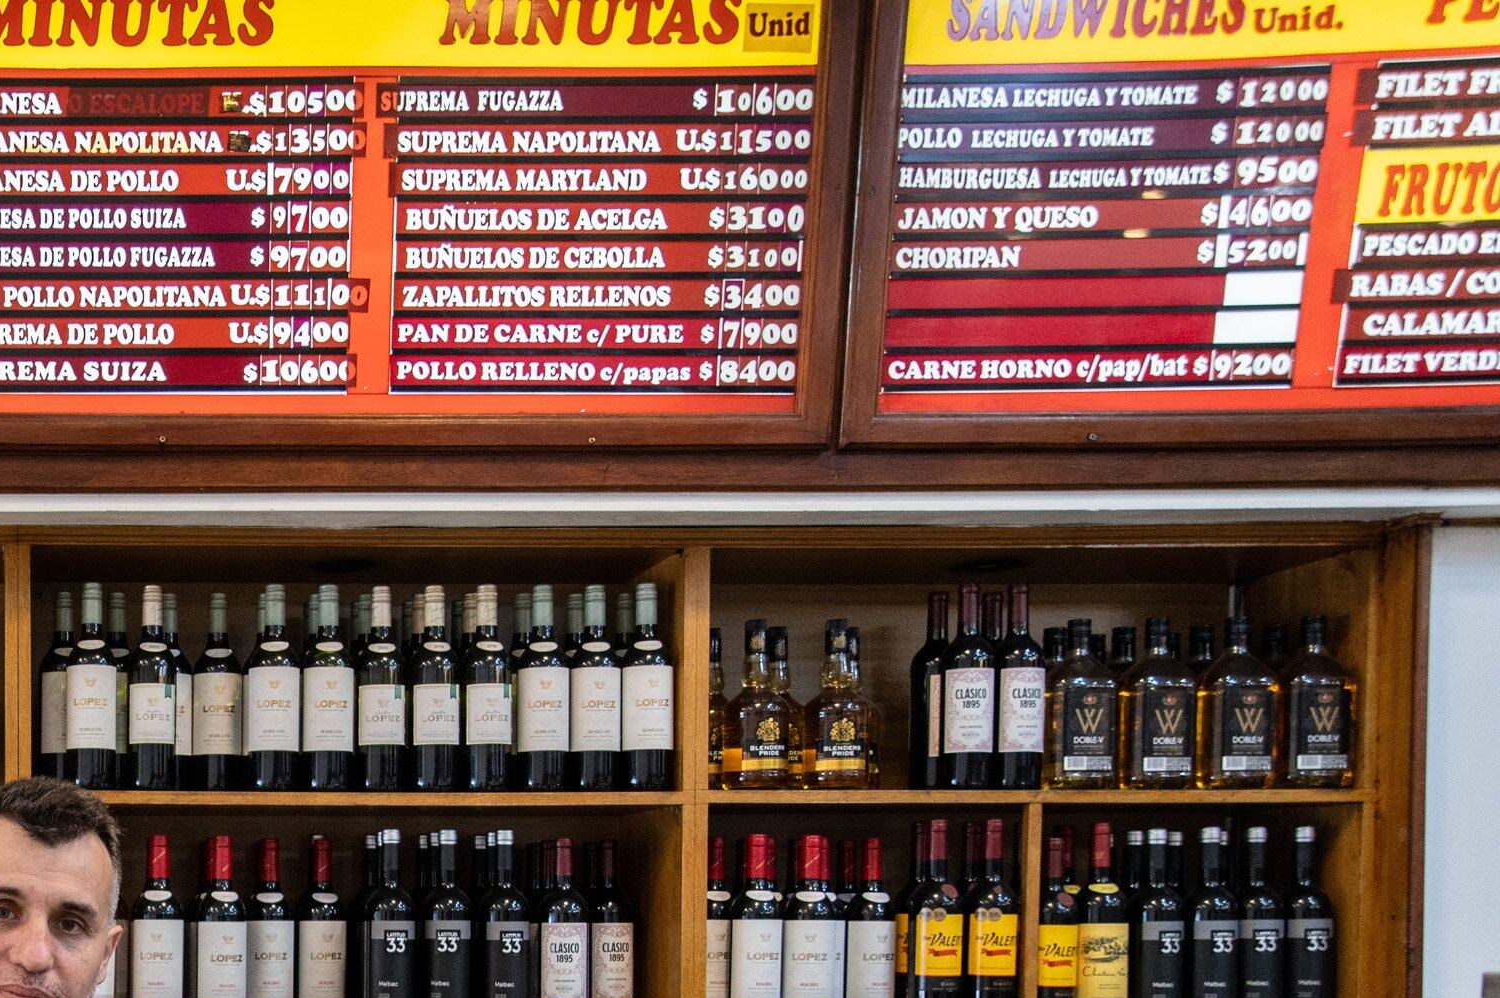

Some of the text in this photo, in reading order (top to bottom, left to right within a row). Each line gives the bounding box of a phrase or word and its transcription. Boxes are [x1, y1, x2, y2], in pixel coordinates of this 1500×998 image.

[438, 0, 810, 45] MINUTAS Unid
[1253, 6, 1344, 33] Unid.
[901, 83, 1199, 109] MILANESA LECHUGA Y TOMATE
[1374, 69, 1469, 99] FILET
[380, 89, 564, 112] SUPREMA FUGAZZA
[970, 128, 1060, 149] LECHUGA
[1062, 128, 1077, 148] Y
[1077, 126, 1155, 148] TOMATE
[1371, 111, 1465, 141] FILET
[74, 130, 224, 154] NAPOLITANA
[397, 130, 662, 154] SUPREMA NAPOLITANA
[69, 169, 103, 193] DE
[105, 169, 180, 193] POLLO
[401, 168, 648, 192] SUPREMA MARYLAND
[898, 164, 1213, 190] HAMBURGUESA LECHUGA Y TOMATE
[39, 208, 65, 230] DE
[67, 207, 128, 230] POLLO
[130, 207, 187, 229] SUIZA
[405, 204, 533, 231] BUÑUELOS
[536, 208, 571, 231] DE
[573, 207, 668, 231] ACELGA
[897, 204, 1100, 233] JAMON Y QUESO
[1360, 230, 1481, 257] PESCADO
[39, 246, 65, 268] DE
[67, 246, 127, 268] POLLO
[129, 246, 216, 268] FUGAZZA
[405, 242, 525, 270] BUÑUELOS
[527, 246, 560, 269] DE
[563, 246, 666, 269] CEBOLLA
[895, 245, 1022, 270] CHORIPAN
[2, 285, 75, 308] POLLO
[79, 285, 228, 308] NAPOLITANA
[402, 285, 672, 308] ZAPALLITOS RELLENOS
[1349, 271, 1448, 298] RABAS
[66, 323, 99, 345] DE
[102, 322, 175, 346] POLLO
[397, 323, 451, 343] PAN
[454, 323, 490, 343] DE
[493, 323, 583, 344] CARNE
[614, 324, 684, 344] PURE
[83, 361, 167, 382] SUIZA
[396, 361, 477, 381] POLLO
[480, 361, 596, 381] RELLENO
[887, 359, 977, 380] CARNE
[979, 358, 1073, 379] HORNO
[1343, 352, 1422, 375] FILET
[962, 700, 980, 708] 1895
[556, 954, 573, 963] 1895
